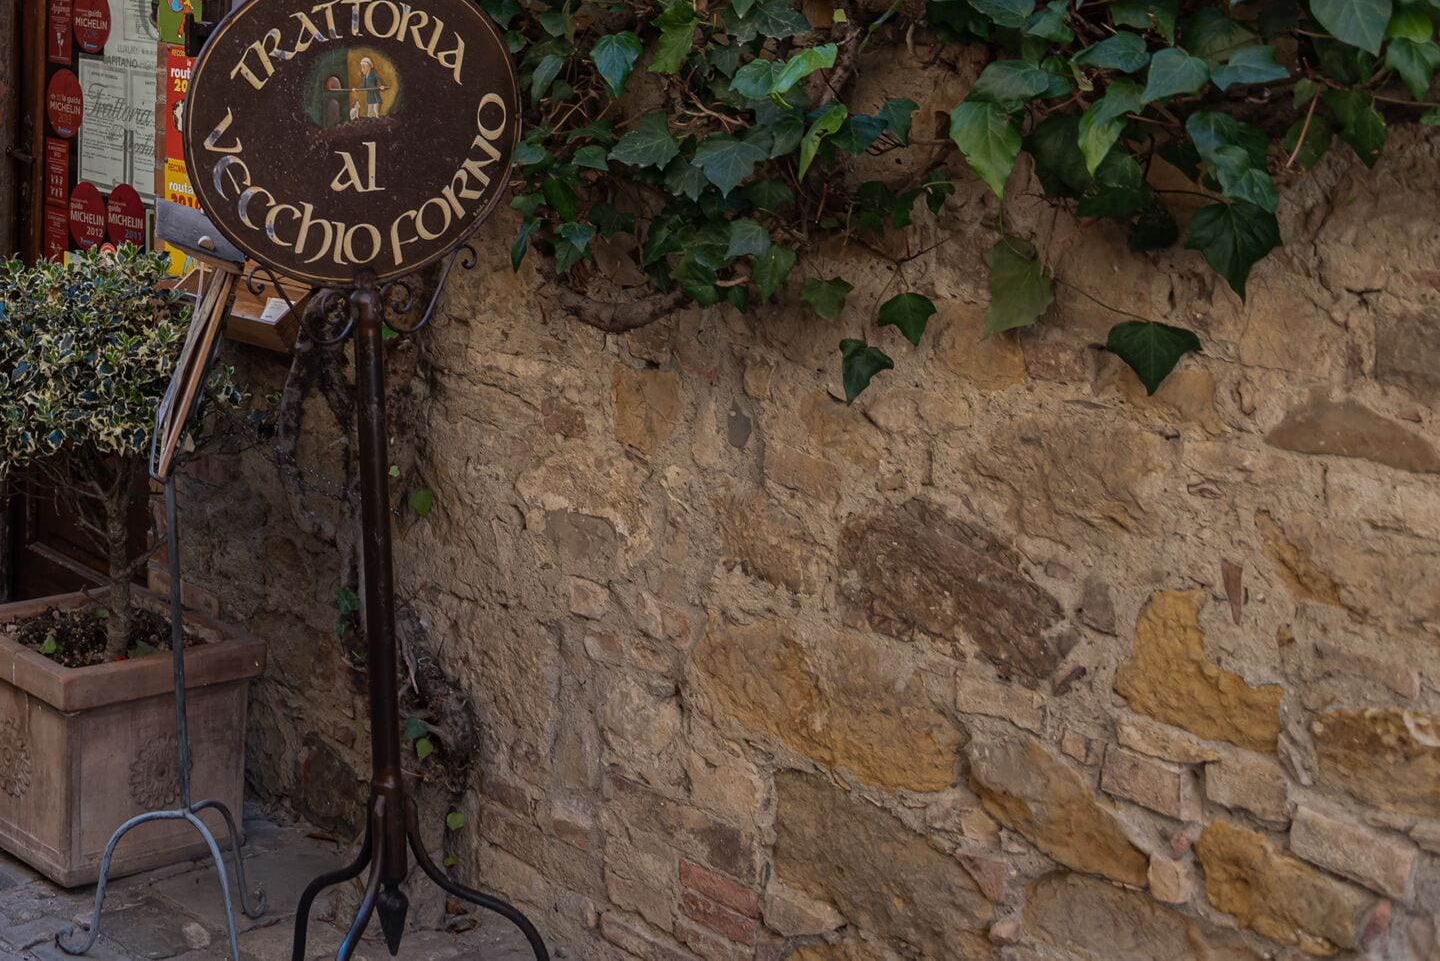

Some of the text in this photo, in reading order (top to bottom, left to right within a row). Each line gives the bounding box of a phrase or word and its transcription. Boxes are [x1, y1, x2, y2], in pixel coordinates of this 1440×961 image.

[75, 17, 107, 30] MICHELIN
[49, 101, 81, 115] MICHELIN
[70, 210, 105, 227] MICHELIN
[108, 213, 143, 230] MICHELIN
[86, 226, 104, 238] 2012
